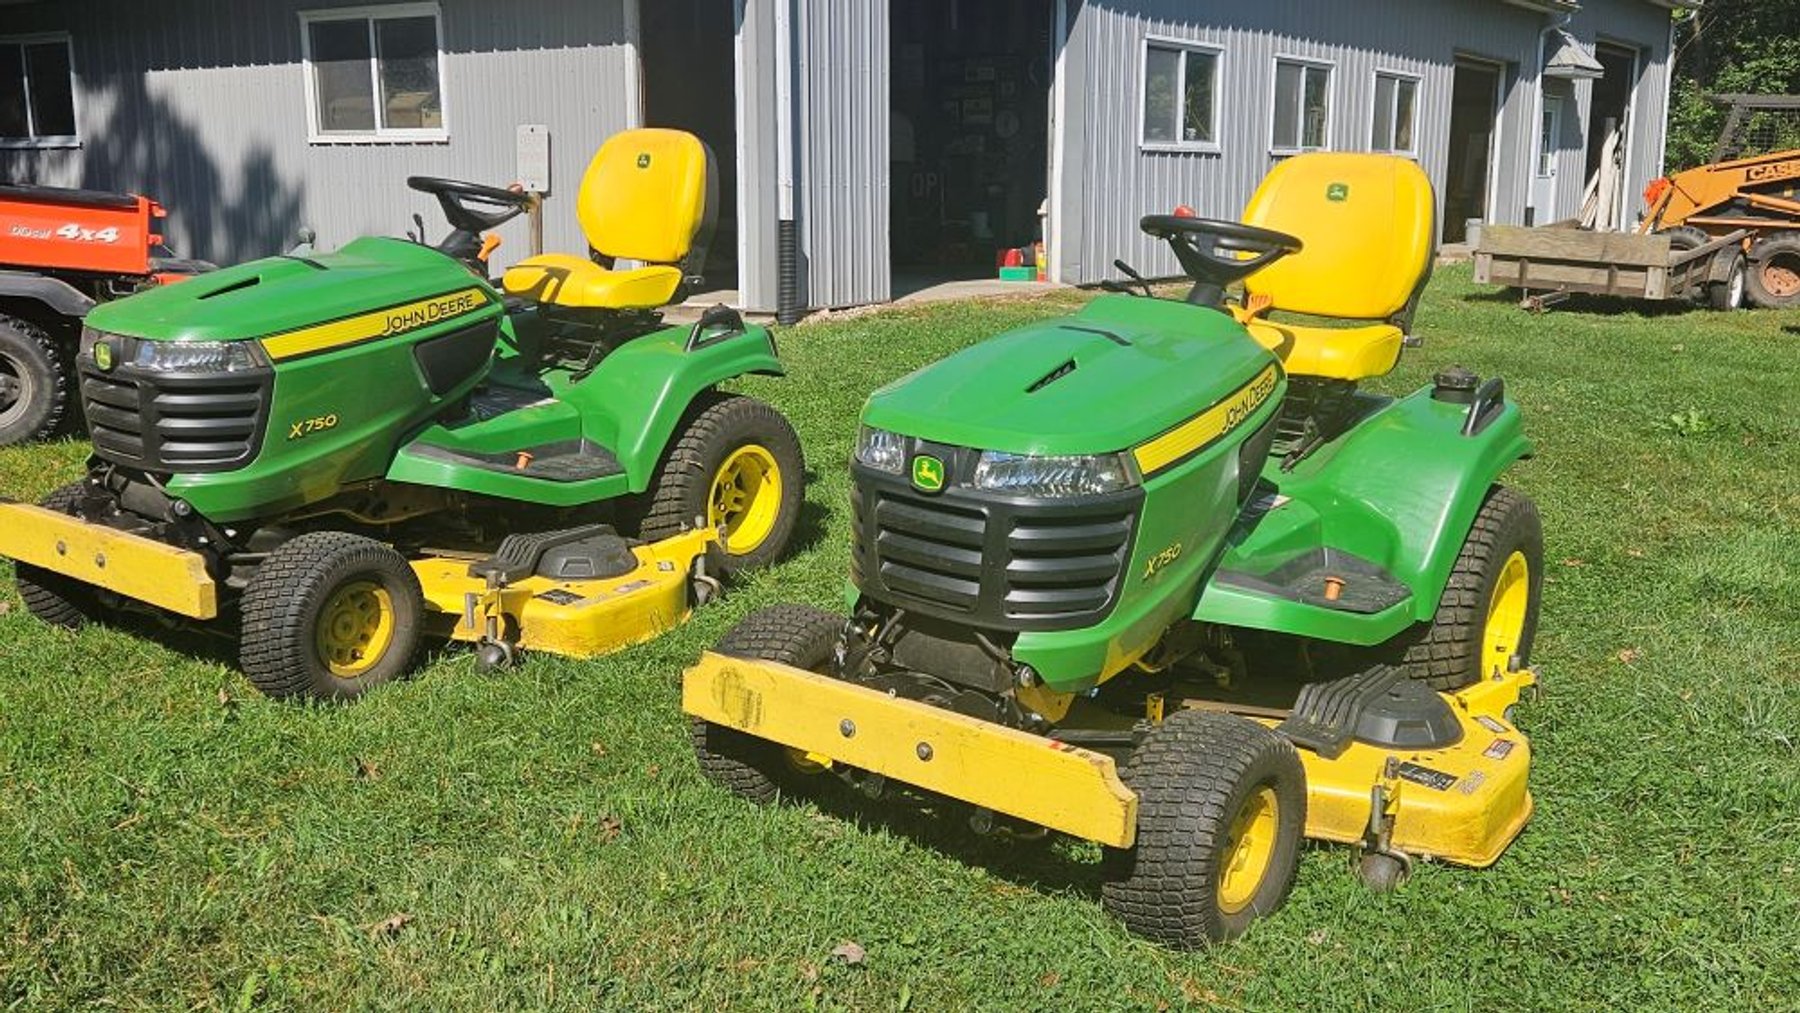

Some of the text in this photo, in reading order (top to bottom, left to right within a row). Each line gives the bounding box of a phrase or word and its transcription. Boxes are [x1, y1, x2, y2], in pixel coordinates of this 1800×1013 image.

[56, 223, 120, 243] 4x4
[383, 293, 472, 334] JOHN DEERE
[1222, 371, 1272, 431] JOHN DEERE
[288, 414, 337, 438] X750
[1143, 543, 1182, 579] X750
